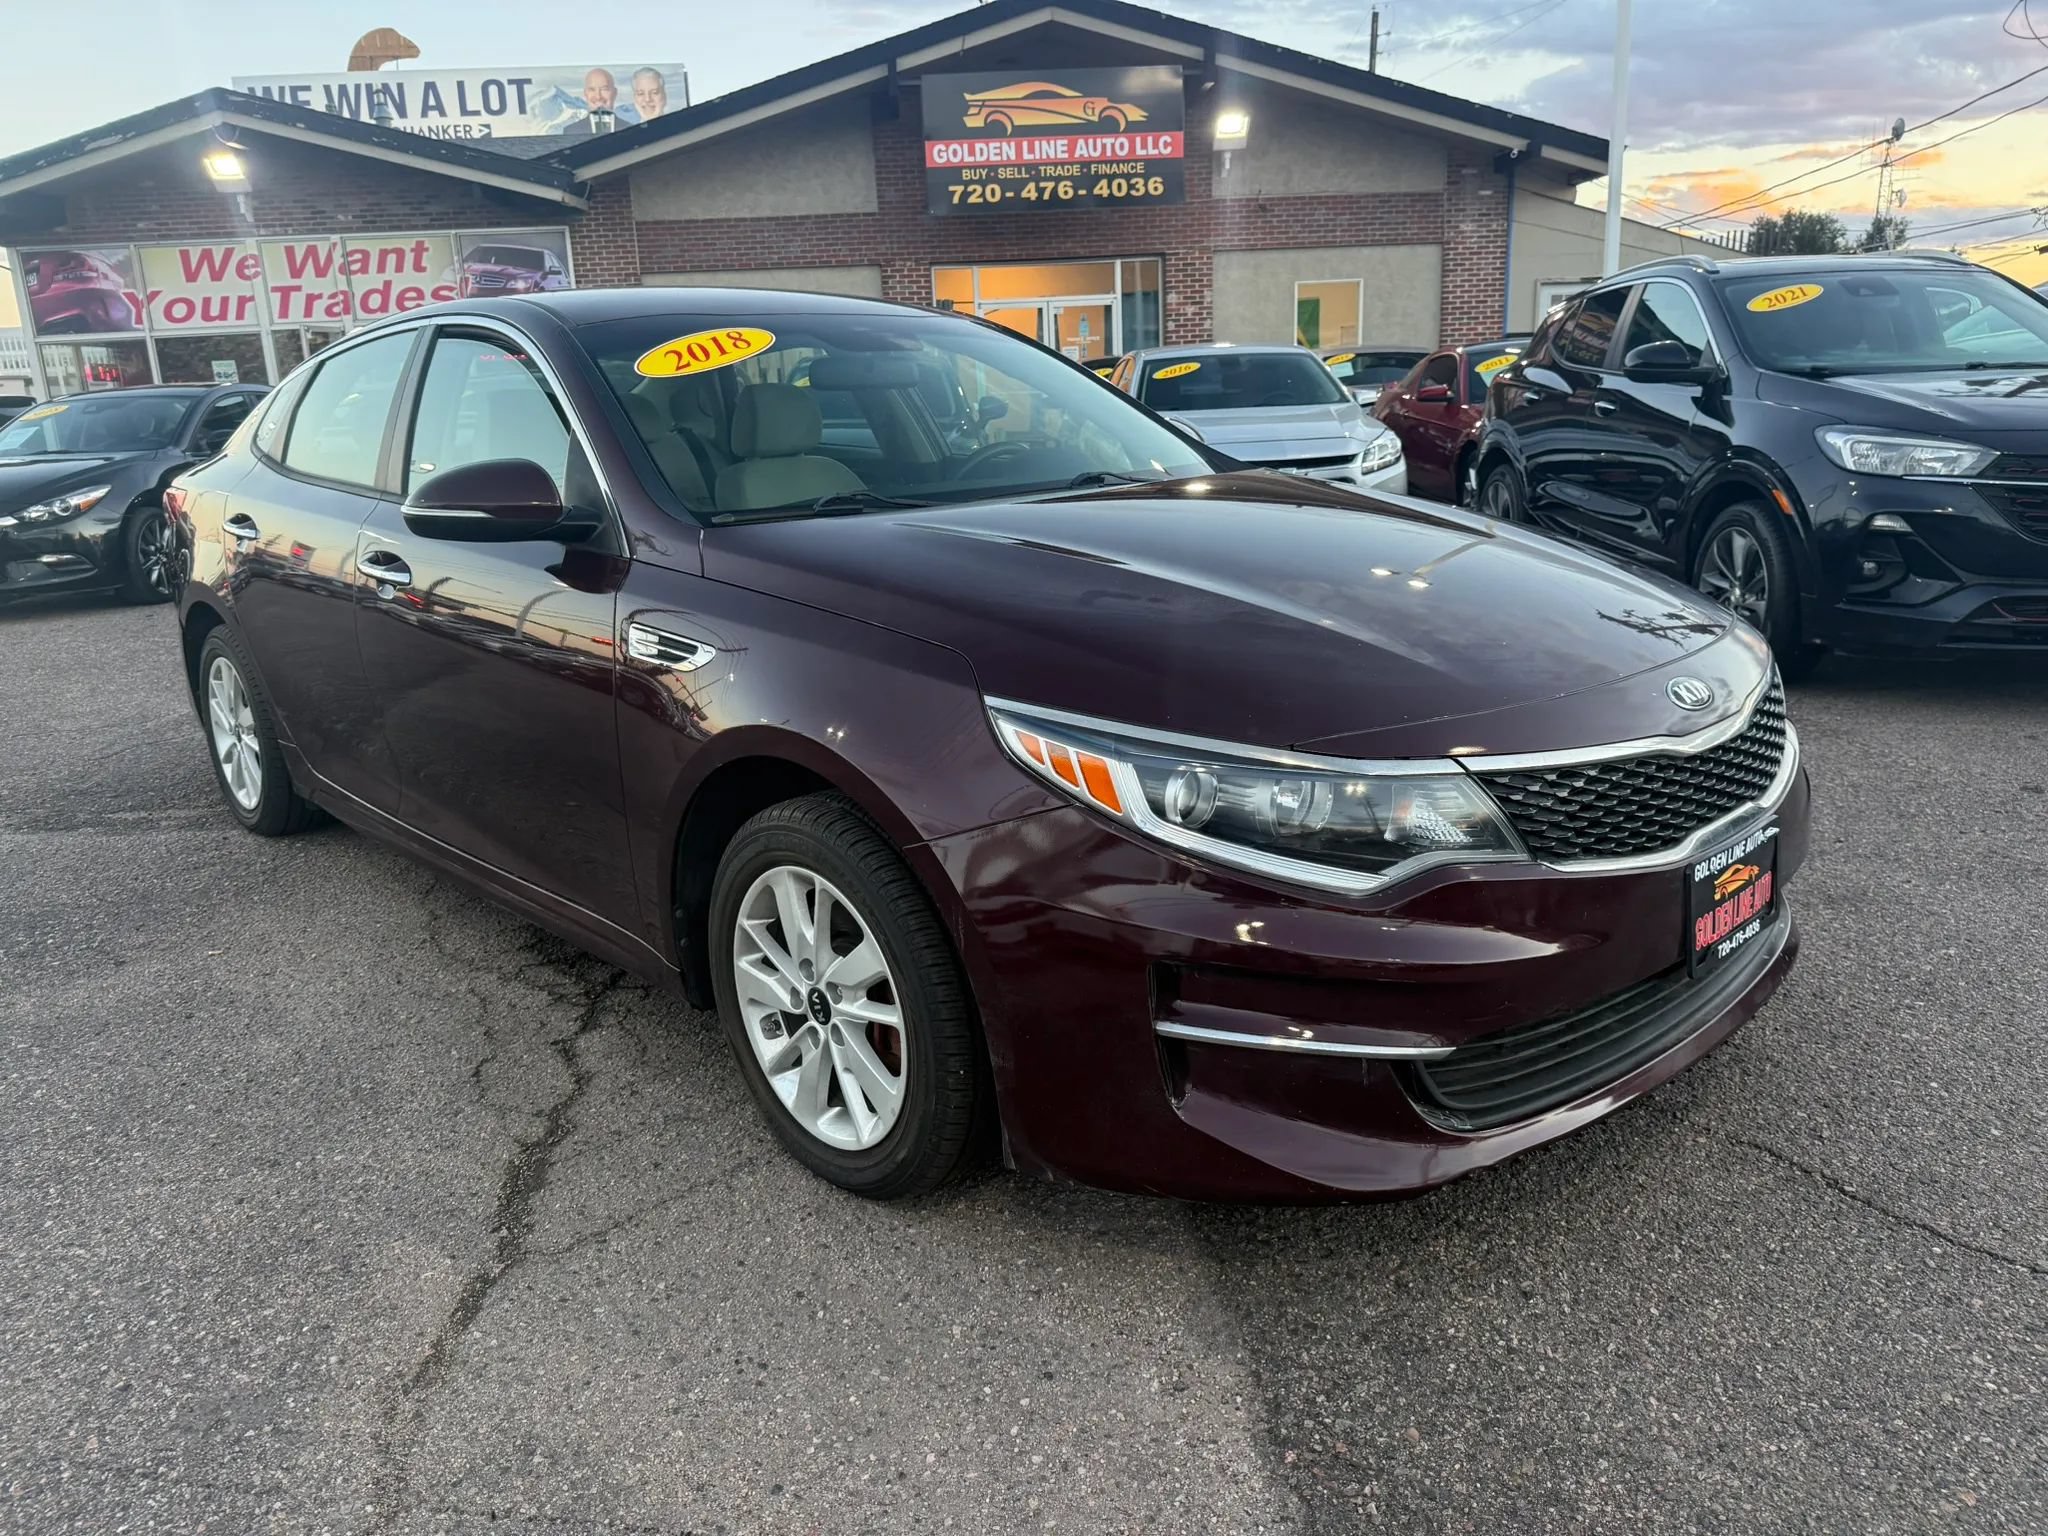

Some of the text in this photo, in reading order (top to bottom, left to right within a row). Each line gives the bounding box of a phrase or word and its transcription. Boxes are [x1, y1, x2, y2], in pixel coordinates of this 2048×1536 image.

[322, 82, 408, 119] WIN
[420, 81, 447, 118] A
[456, 78, 532, 117] LOT
[932, 135, 1173, 163] GOLDEN LINE AUTO LLC
[962, 162, 1145, 181] BUY SELL TRADE FINANCE
[178, 239, 430, 284] We Want
[122, 290, 256, 326] Your
[1762, 286, 1808, 309] 2021
[663, 330, 752, 372] 2018
[1162, 364, 1192, 377] 2016
[1694, 850, 1728, 882] GOLDEN
[1728, 840, 1746, 865] LINE
[1695, 870, 1772, 951] GOLDEN LINE AUTO
[812, 992, 826, 1022] KIA
